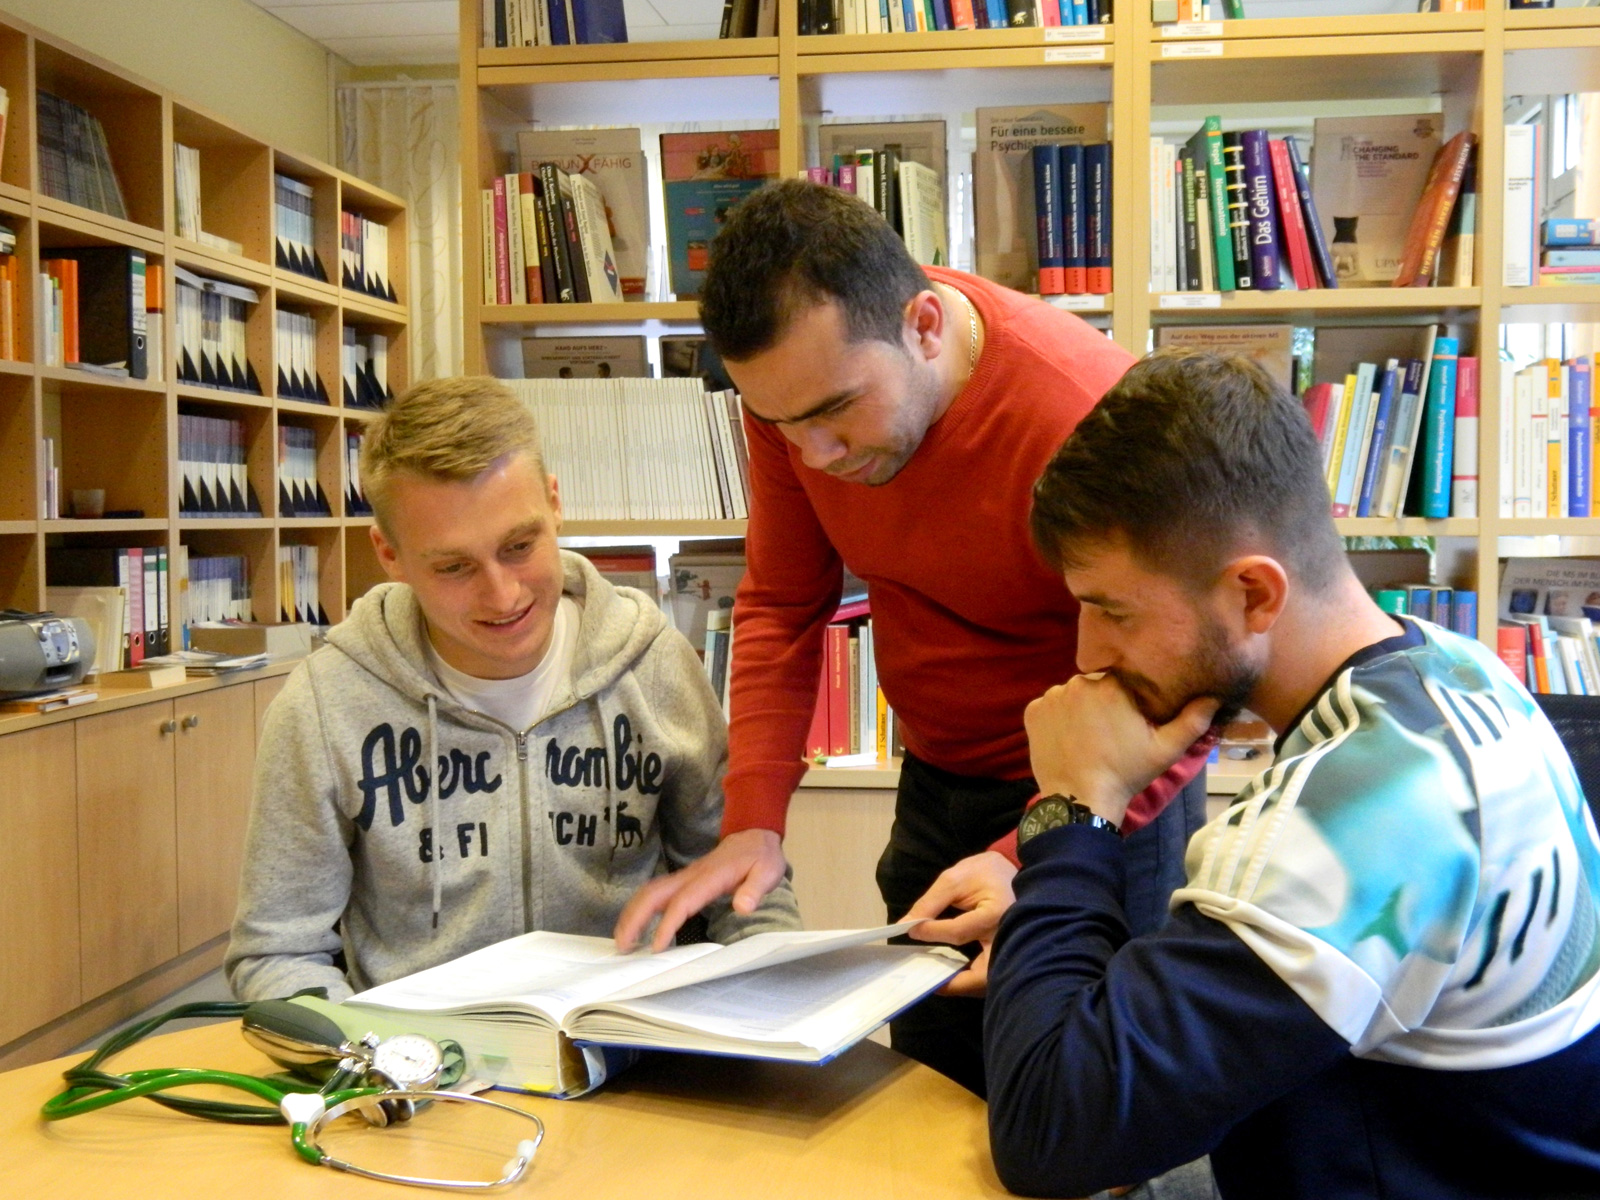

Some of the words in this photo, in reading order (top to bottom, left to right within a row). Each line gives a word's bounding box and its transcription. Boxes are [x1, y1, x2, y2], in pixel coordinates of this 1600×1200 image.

[990, 126, 1009, 138] Für
[1012, 126, 1037, 136] eine
[1040, 125, 1085, 136] bessere
[1210, 141, 1222, 165] Trepel
[1373, 152, 1419, 160] STANDARD
[1451, 142, 1470, 182] ANDREASEN
[1183, 157, 1196, 222] Neuromythologie
[1251, 174, 1270, 218] Gehirn
[1213, 177, 1229, 236] Neuroanatomie
[1435, 199, 1451, 227] BRAVE
[1254, 220, 1272, 244] Das
[1428, 228, 1442, 248] NEW
[1419, 249, 1434, 275] BRAIN
[1533, 578, 1569, 586] MENSCH
